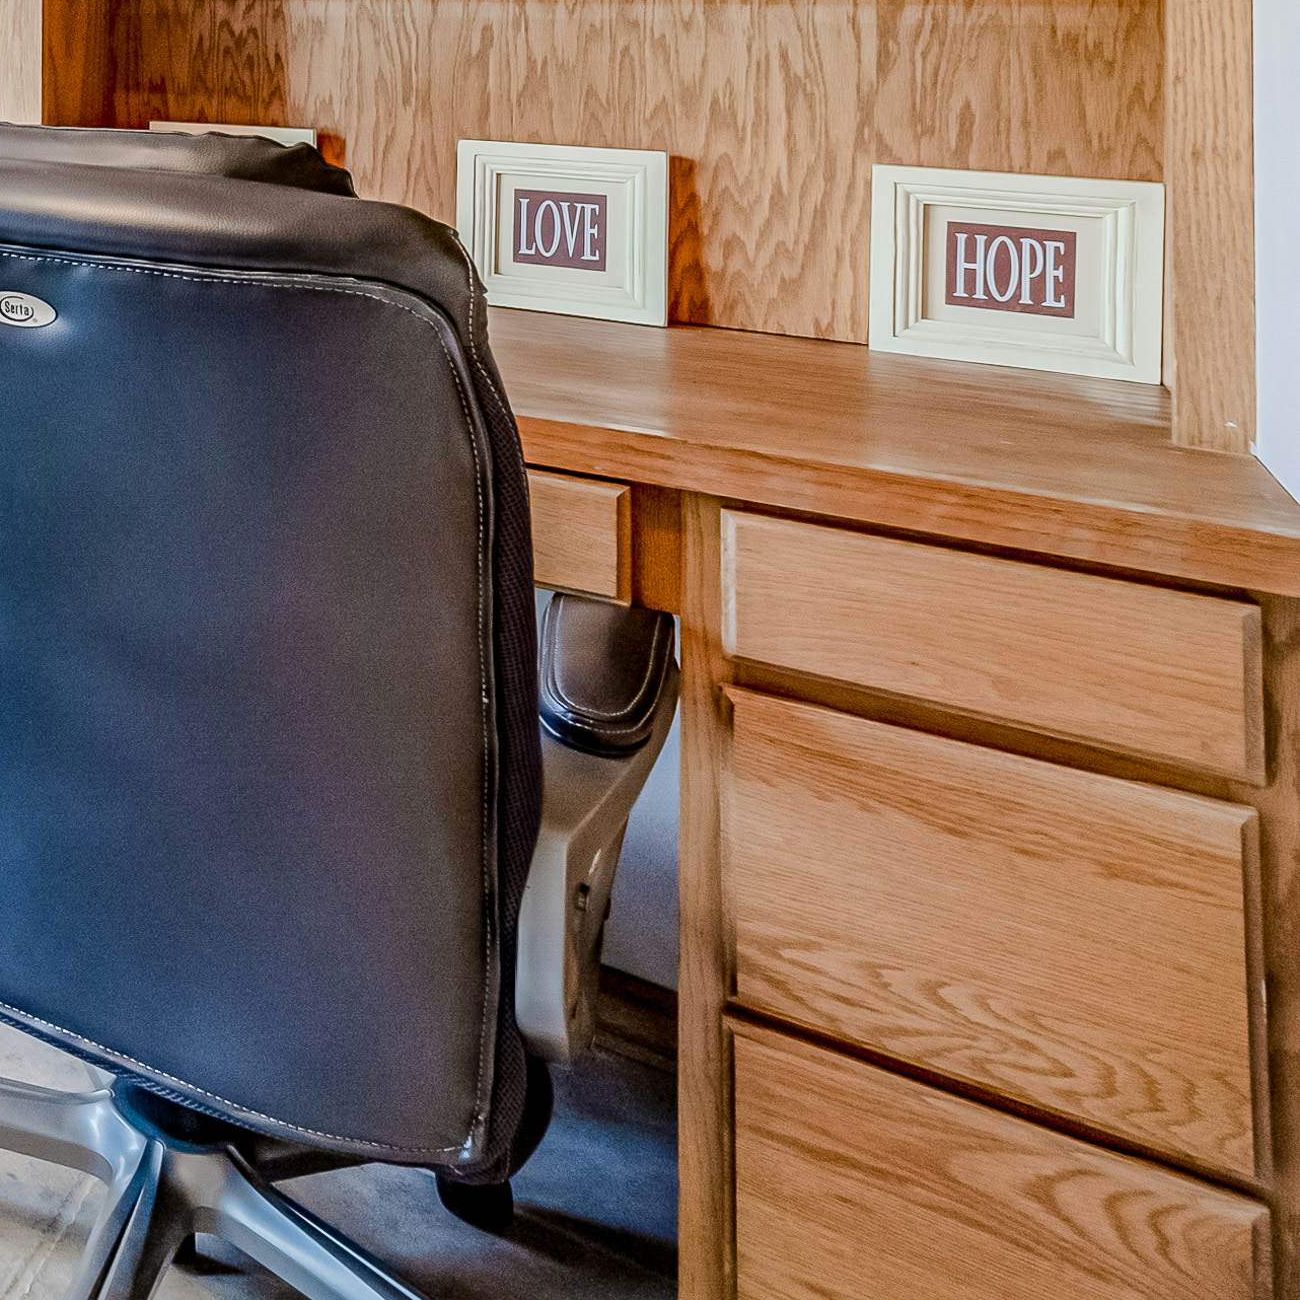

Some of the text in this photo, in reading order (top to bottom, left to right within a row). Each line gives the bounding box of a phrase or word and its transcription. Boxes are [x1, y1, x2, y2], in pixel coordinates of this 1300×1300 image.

[518, 198, 600, 261] LOVE
[952, 232, 1066, 308] HOPE
[5, 301, 30, 316] Serta
